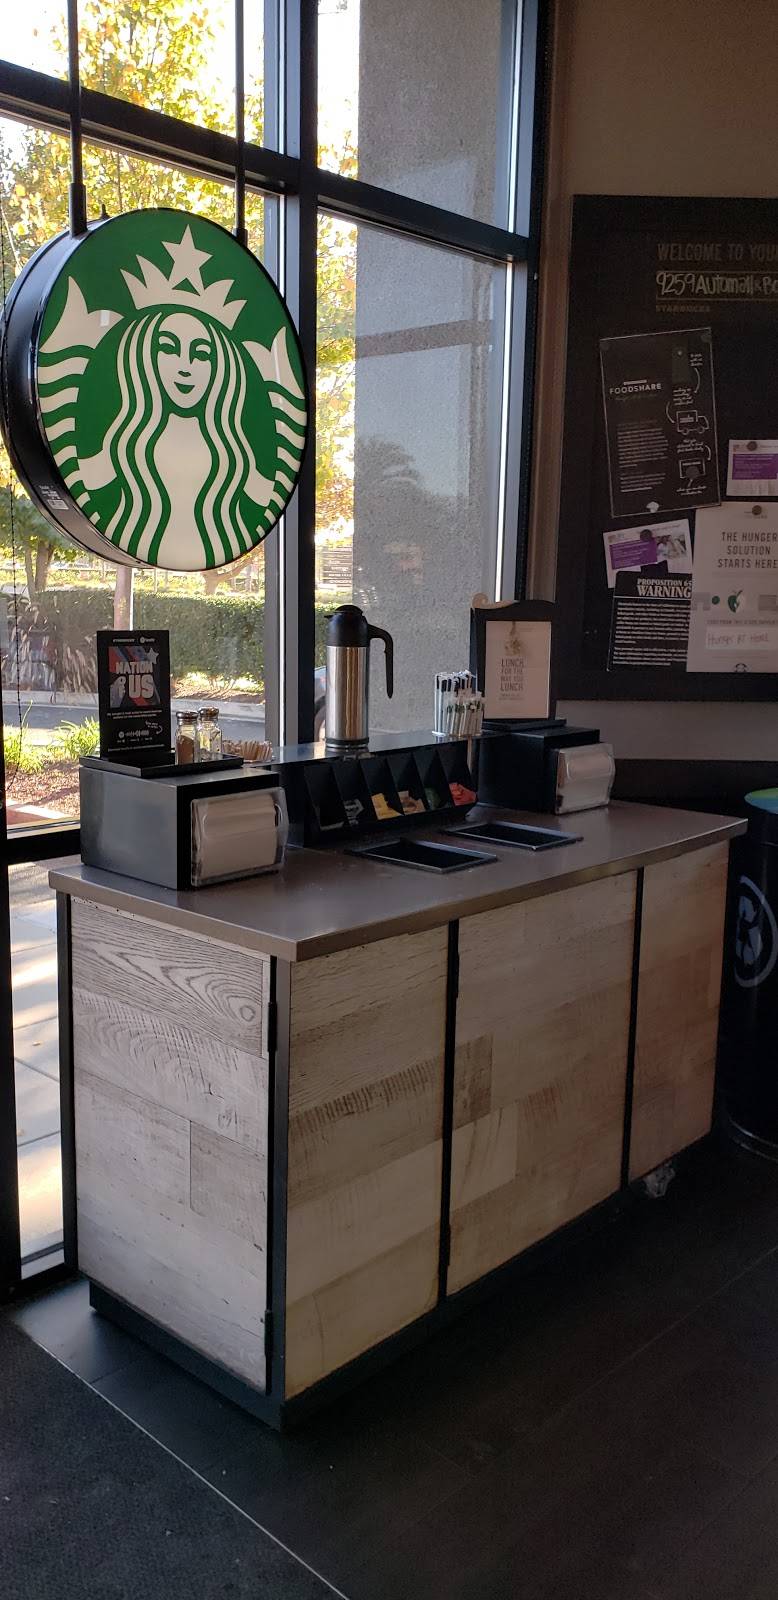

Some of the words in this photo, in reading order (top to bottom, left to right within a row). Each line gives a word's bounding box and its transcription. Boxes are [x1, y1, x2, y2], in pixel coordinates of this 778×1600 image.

[657, 243, 722, 261] WELCOME
[727, 244, 744, 261] TO
[656, 271, 696, 296] 9259
[609, 383, 662, 395] FOODSHARE
[721, 531, 738, 542] THE
[741, 531, 778, 542] HUNGER
[726, 545, 771, 556] SOLUTION
[717, 558, 751, 569] STARTS
[754, 558, 778, 569] HERE
[636, 578, 683, 587] PROPOSITION
[636, 585, 692, 598] WARNING
[115, 661, 154, 675] NATION
[128, 674, 154, 699] US
